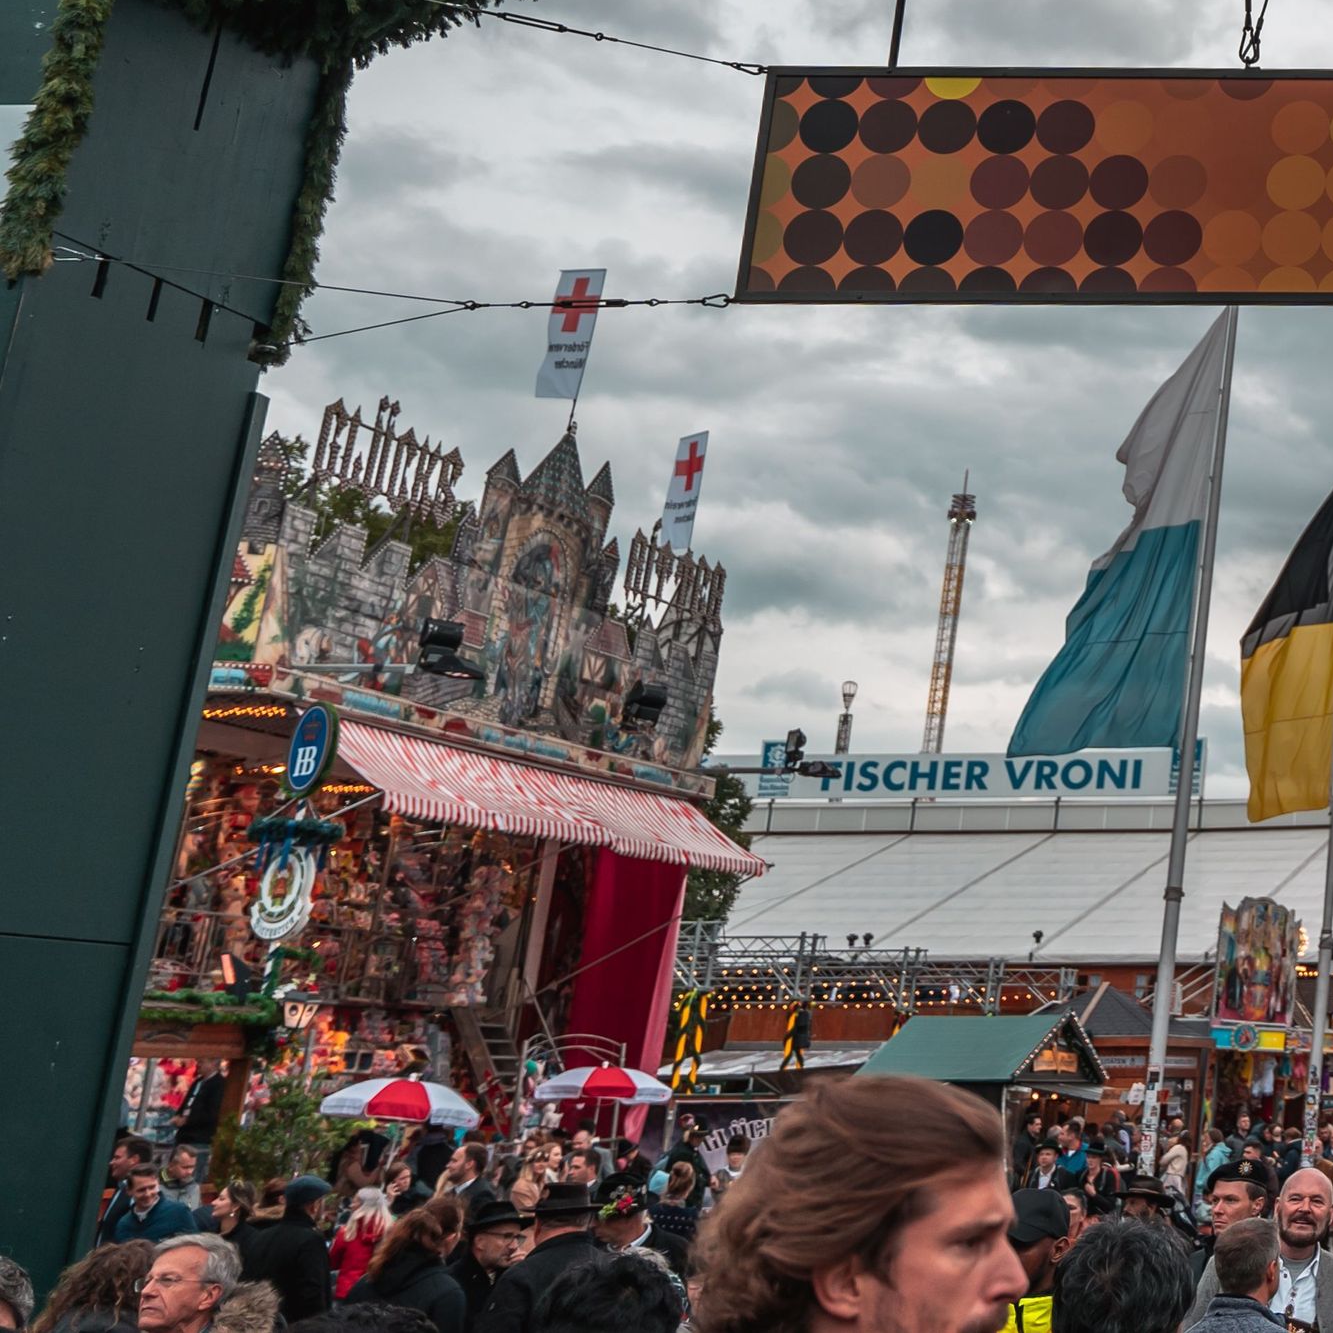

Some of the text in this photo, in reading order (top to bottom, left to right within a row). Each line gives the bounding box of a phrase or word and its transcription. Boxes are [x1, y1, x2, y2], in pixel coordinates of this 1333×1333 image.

[292, 745, 318, 777] HB
[820, 760, 990, 791] FISCHER
[1004, 759, 1143, 790] VRONI
